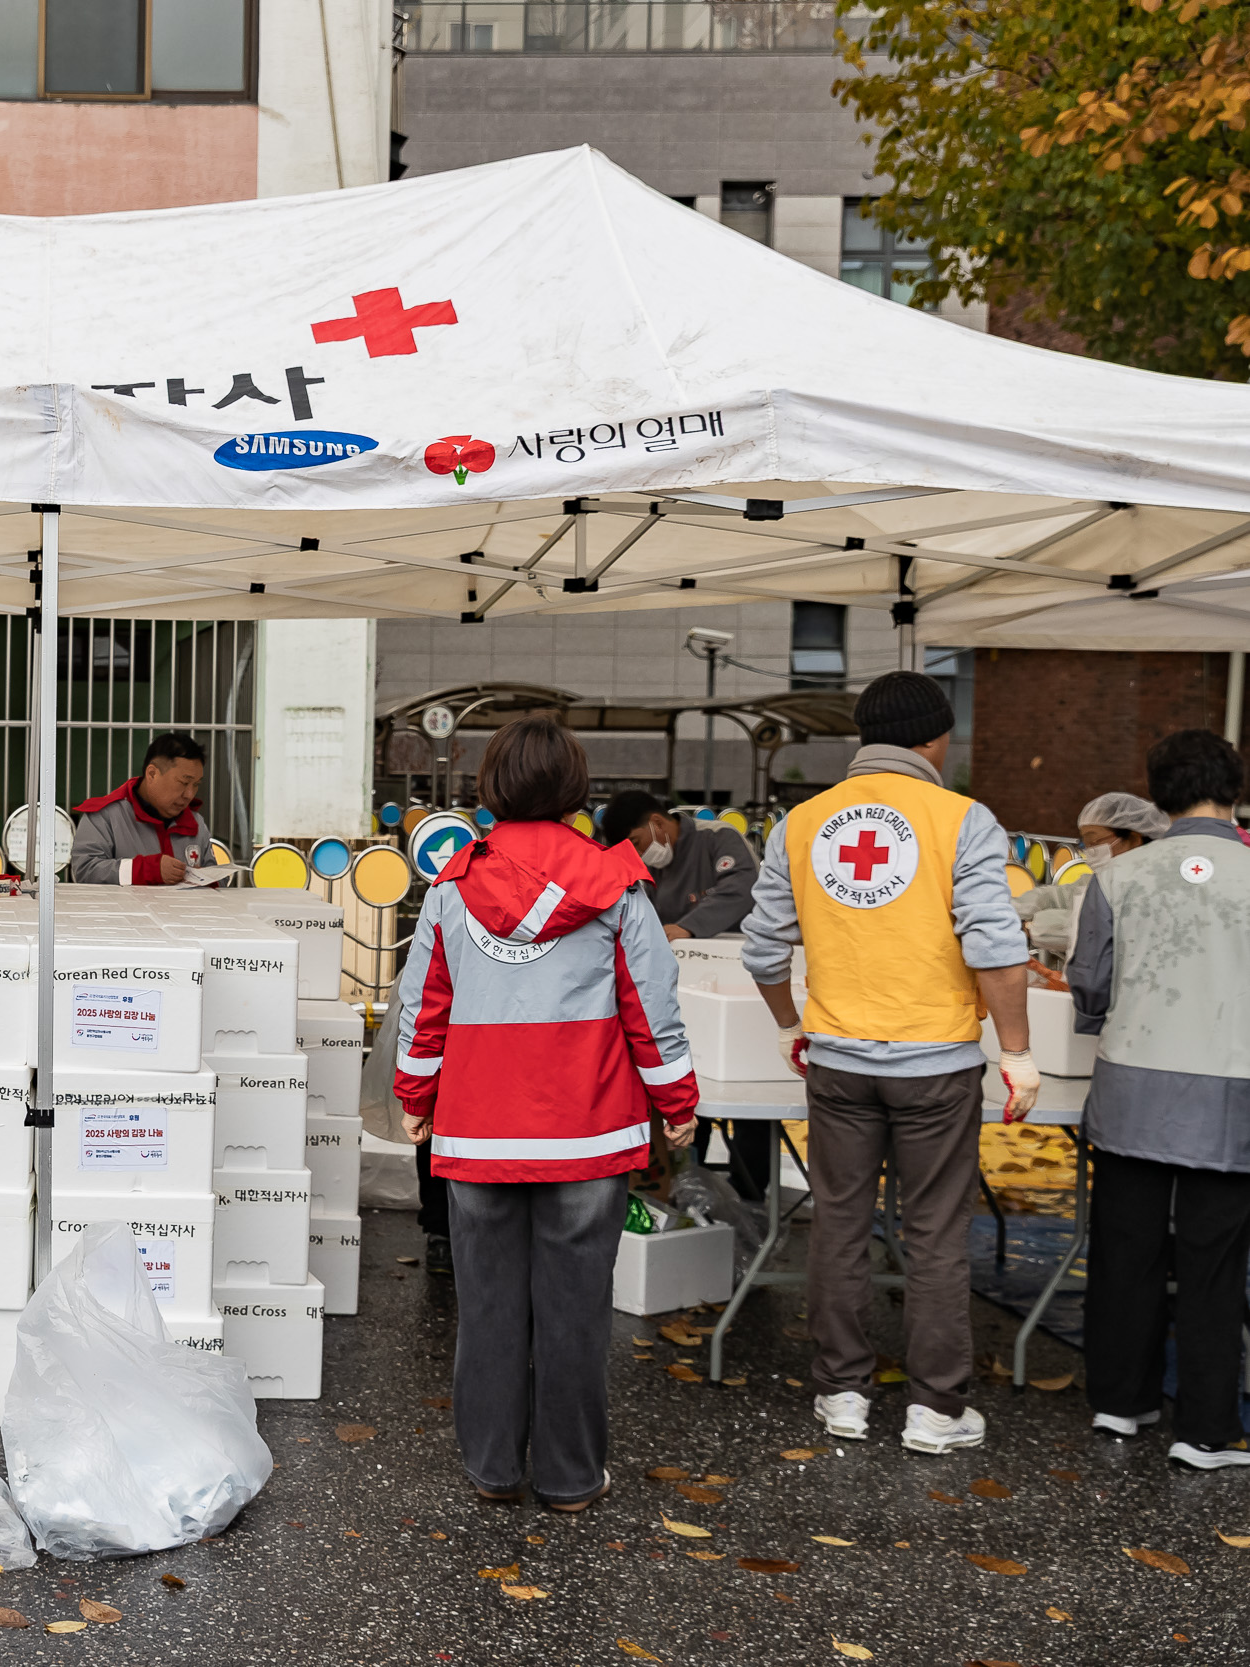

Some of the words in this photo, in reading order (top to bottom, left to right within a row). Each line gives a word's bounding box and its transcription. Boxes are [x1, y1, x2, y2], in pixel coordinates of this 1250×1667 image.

[636, 411, 724, 452] 열매
[820, 808, 863, 841] KOREAN
[865, 807, 885, 819] RED
[884, 811, 912, 842] CROSS
[824, 872, 905, 905] 대한적십자사
[275, 920, 302, 929] Cross
[306, 921, 325, 929] Red
[211, 957, 283, 973] 대한적십자사
[102, 968, 129, 981] Red
[132, 967, 170, 980] Cross
[77, 1008, 98, 1017] 2025
[98, 1009, 122, 1019] 사랑의
[123, 1010, 139, 1021] 김장
[140, 1012, 156, 1022] 나눔
[321, 1037, 362, 1049] Korean
[240, 1076, 285, 1089] Korean
[85, 1129, 106, 1138] 2025
[106, 1129, 130, 1139] 사랑의
[131, 1128, 146, 1138] 김장
[147, 1129, 163, 1137] 나눔
[234, 1189, 308, 1203] 대한적십자사
[224, 1305, 248, 1316] Red
[252, 1305, 287, 1317] Cross
